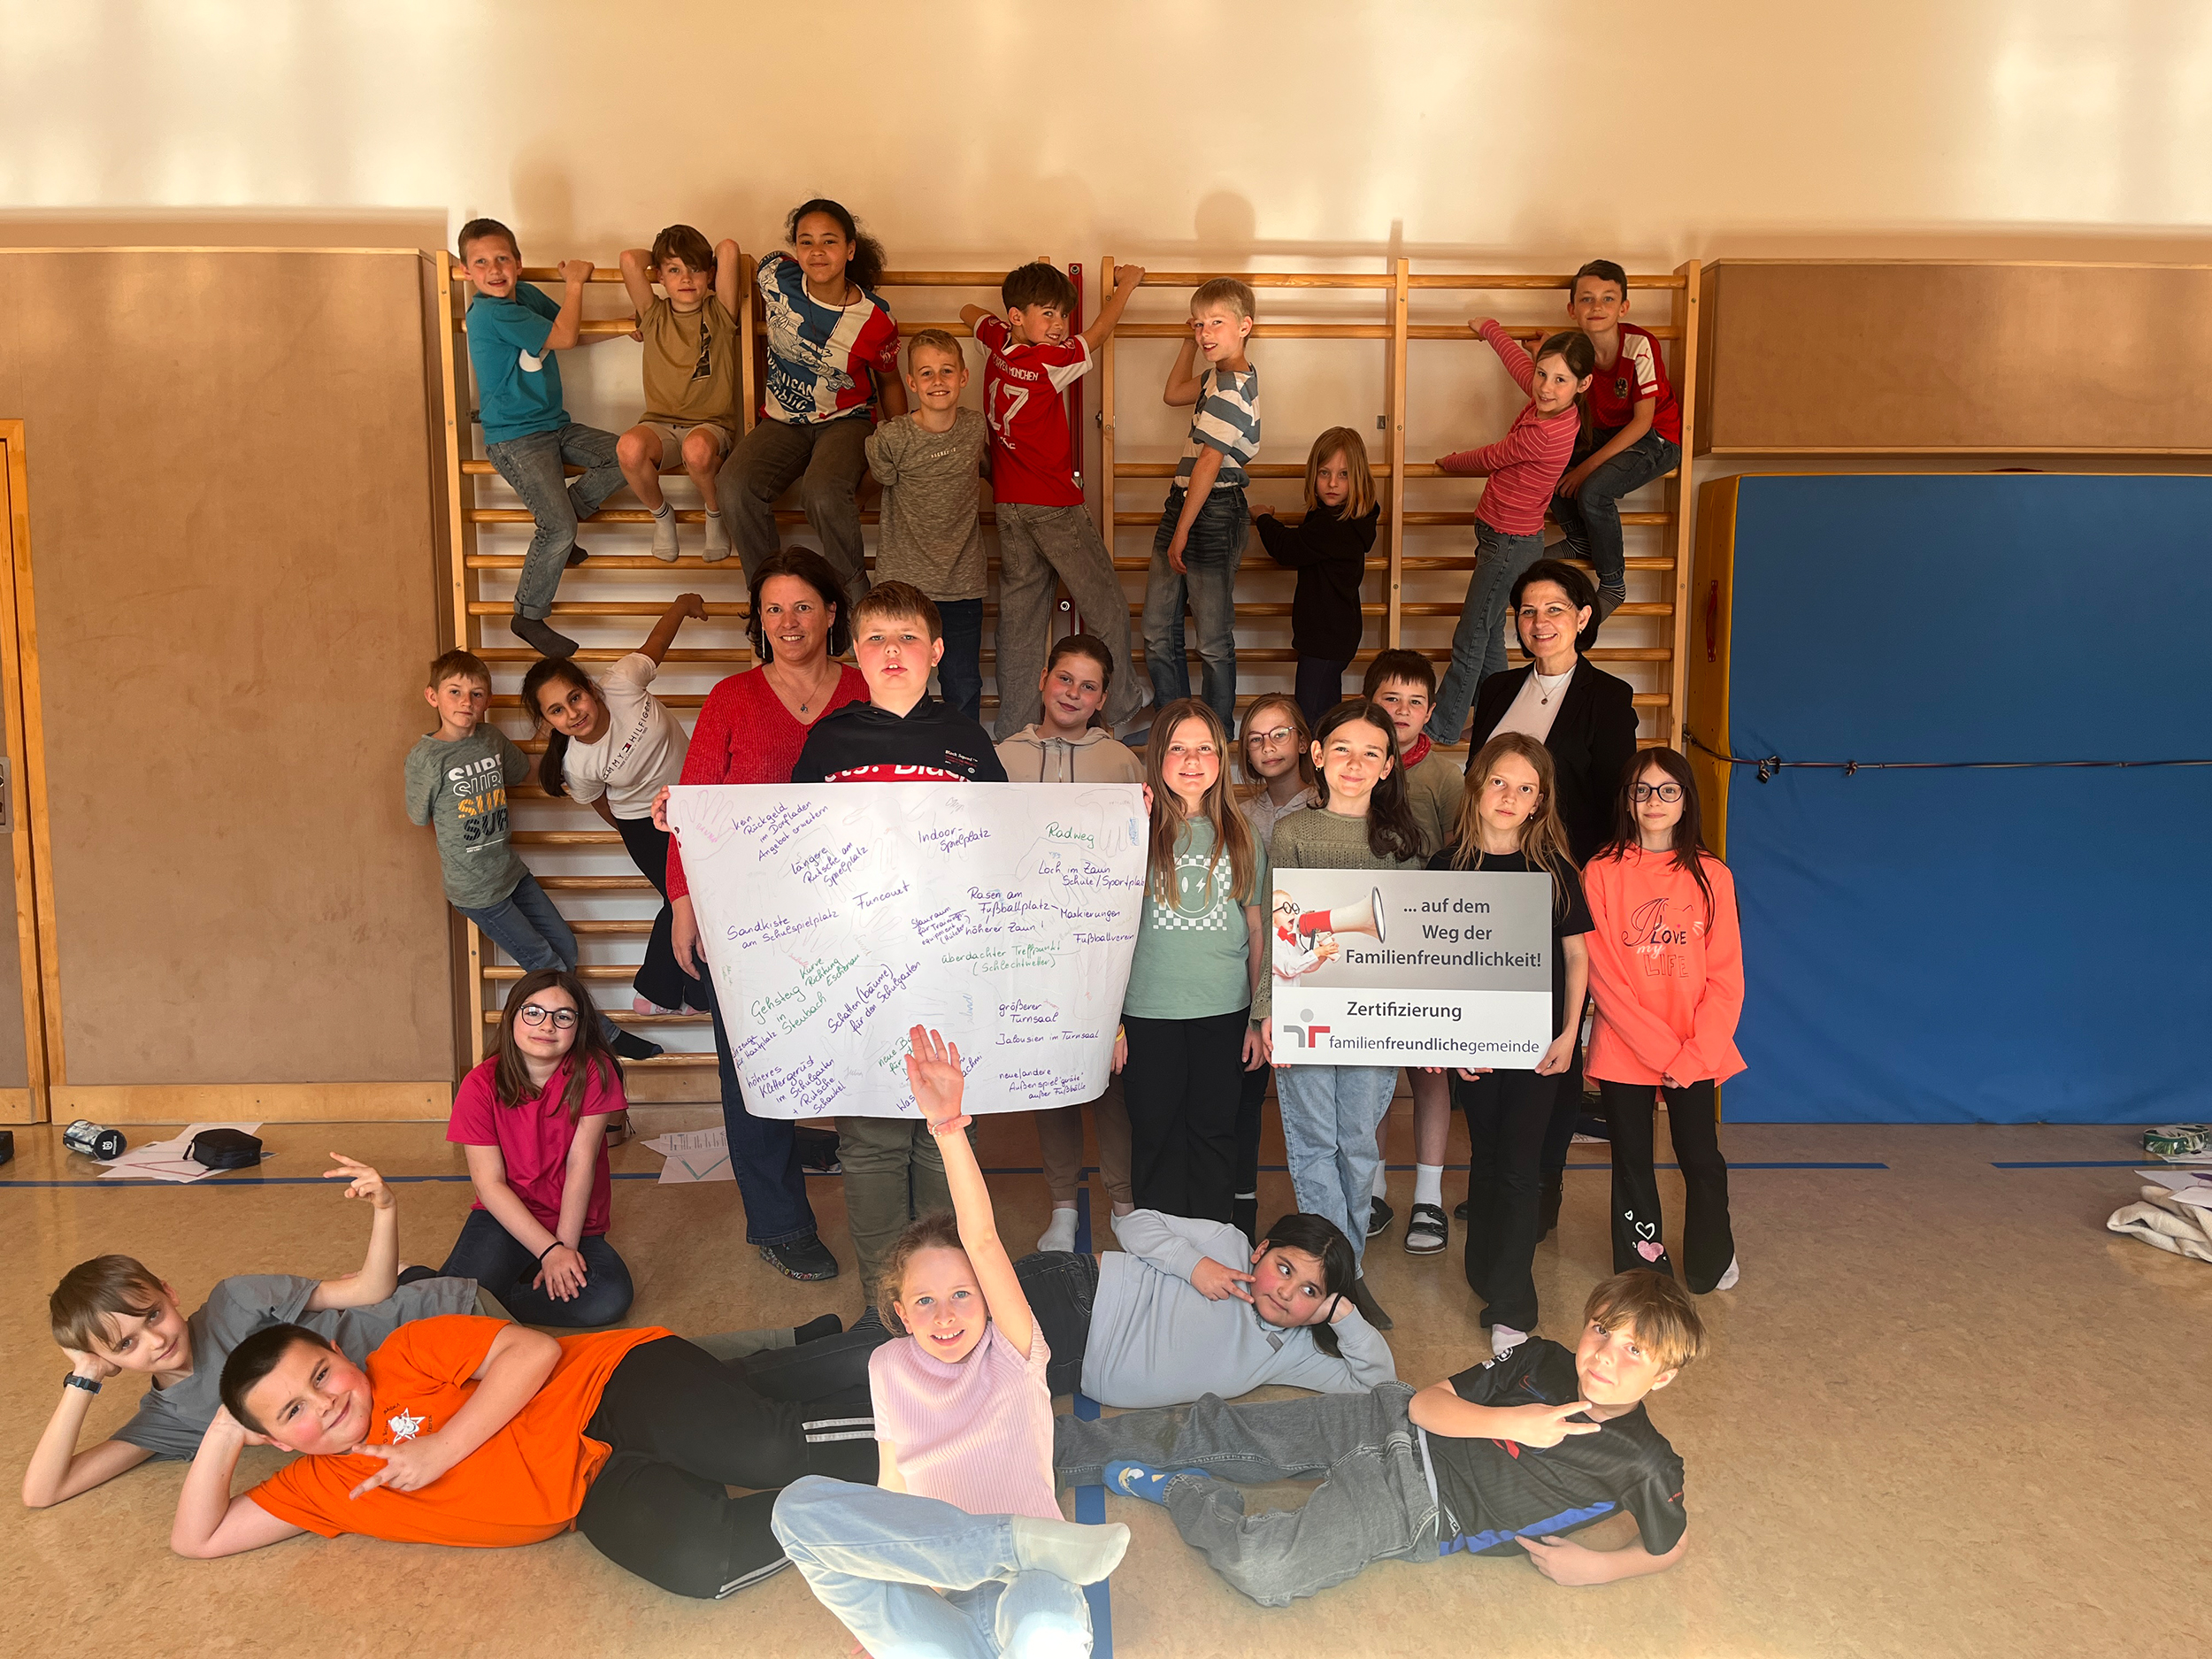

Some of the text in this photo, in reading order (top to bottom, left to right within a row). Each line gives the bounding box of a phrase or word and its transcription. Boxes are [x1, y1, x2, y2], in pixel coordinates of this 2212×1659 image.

[987, 377, 1029, 436] 17
[629, 701, 650, 742] HILFIGER
[732, 815, 752, 832] kein
[743, 802, 788, 835] Rückgeld
[760, 801, 811, 843] im Dorfladen
[758, 805, 828, 861] Angebot erweitern
[918, 827, 963, 843] Indoor-
[940, 828, 991, 852] Spielplatz
[1046, 821, 1094, 849] Radweg
[791, 847, 828, 875] längere
[803, 841, 854, 884] Rutsche am
[824, 847, 869, 887] Spielplatz
[1038, 860, 1061, 874] Loch
[1084, 862, 1110, 874] Zaun
[852, 879, 910, 910] Funcourt
[967, 886, 1023, 900] Rasen am
[978, 899, 1050, 917] Fußballplatz
[1060, 906, 1121, 922] Markierungen
[1421, 898, 1449, 913] auf
[1453, 898, 1490, 914] dem
[726, 916, 790, 941] Sandkiste
[741, 909, 840, 949] am Schulspielplatz
[965, 924, 1002, 935] höherer
[1073, 933, 1134, 945] Fußballverein
[1422, 925, 1493, 943] Weg der
[1650, 930, 1686, 945] LOVE
[941, 946, 1006, 964] überdachter
[1346, 949, 1542, 968] Familienfreundlichkeit!
[1636, 944, 1666, 959] my
[799, 957, 824, 979] Kurve
[804, 958, 841, 987] Richtung
[1643, 954, 1689, 978] LIFE
[751, 986, 806, 1025] Gehsteig
[850, 961, 921, 1036] für den Schulgarten
[998, 999, 1042, 1018] größerer
[776, 1013, 787, 1023] in
[781, 991, 827, 1035] Steubach
[1010, 1010, 1059, 1024] Turnsaal
[1346, 1001, 1463, 1021] Zertifizierung
[995, 1033, 1044, 1045] Jalousien
[1061, 1030, 1100, 1041] Turnsaal
[1329, 1035, 1540, 1055] familienfreundlichegemeinde
[878, 1049, 897, 1067] neue
[888, 1059, 902, 1075] für
[745, 1065, 782, 1089] höheres
[759, 1055, 815, 1098] Klettergerüst
[776, 1058, 835, 1103] im Schulgarten
[800, 1077, 836, 1108] Rutsche
[813, 1080, 847, 1115] Schaukel
[896, 1094, 916, 1112] Was
[1028, 1090, 1051, 1100] außer
